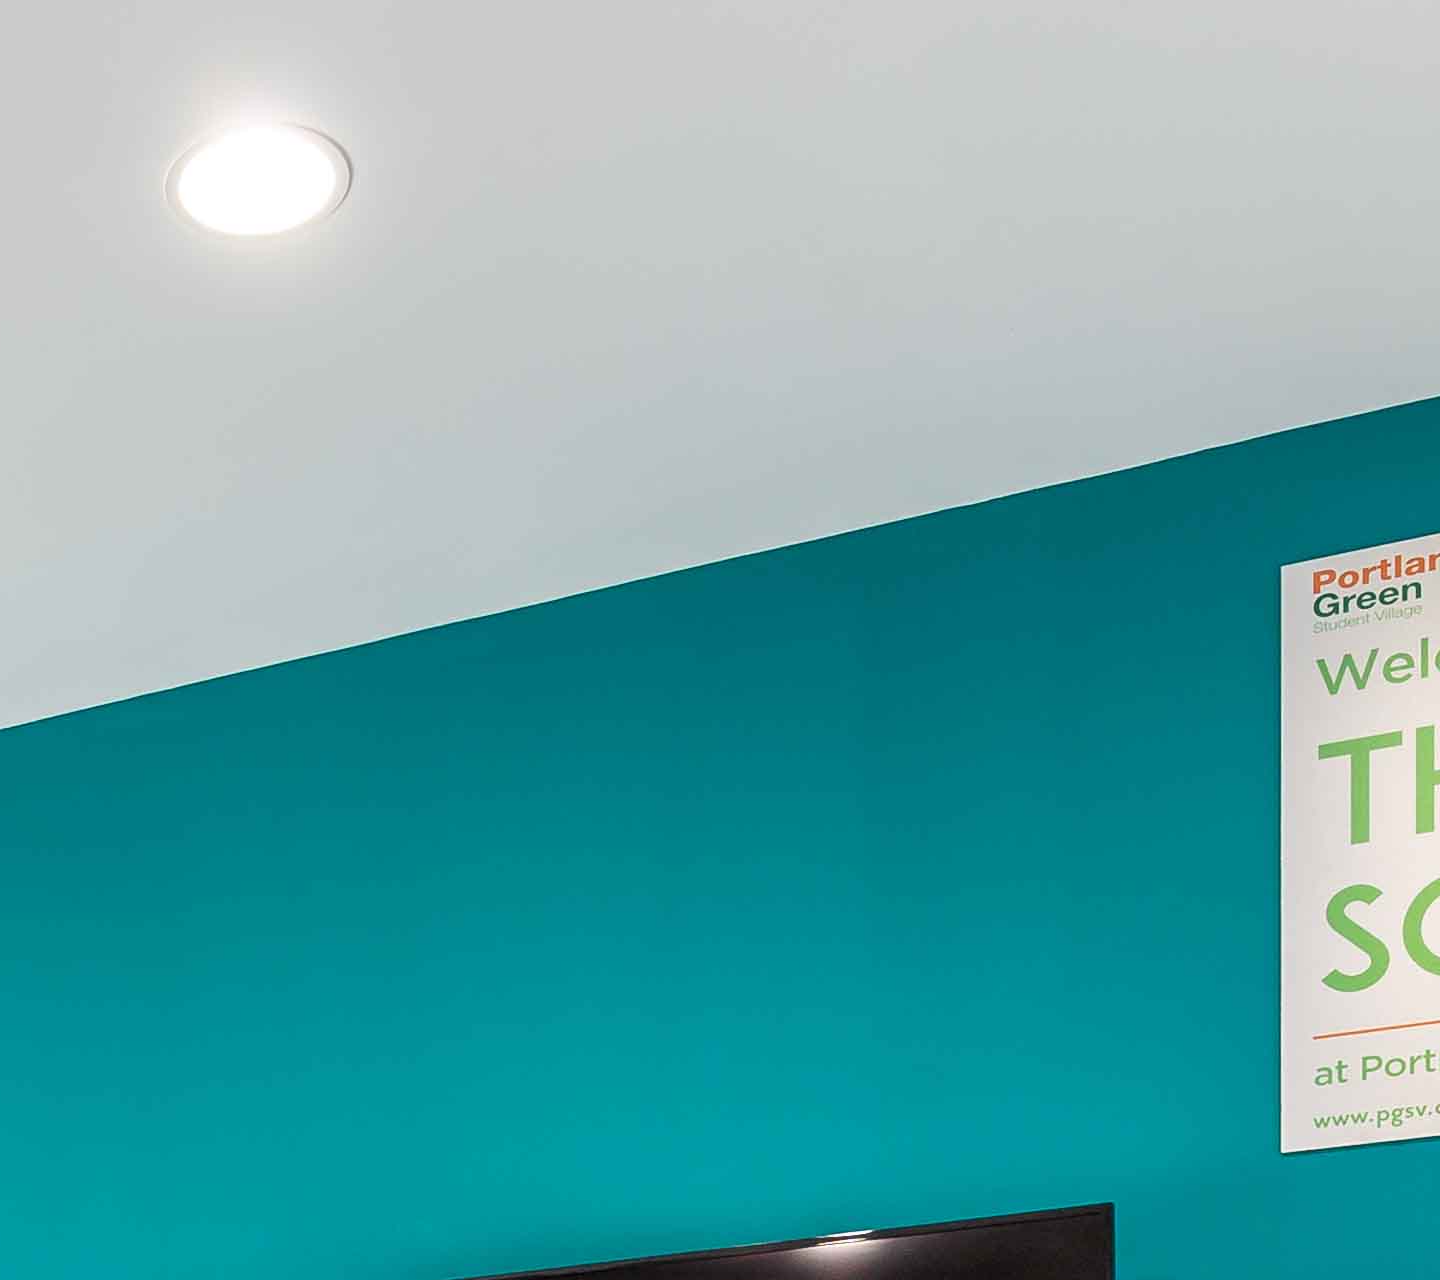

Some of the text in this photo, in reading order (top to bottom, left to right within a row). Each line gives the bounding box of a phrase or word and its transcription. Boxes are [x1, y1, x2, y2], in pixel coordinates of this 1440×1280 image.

[1313, 581, 1422, 618] Green
[1312, 604, 1424, 634] Student Village
[1314, 1059, 1349, 1087] at
